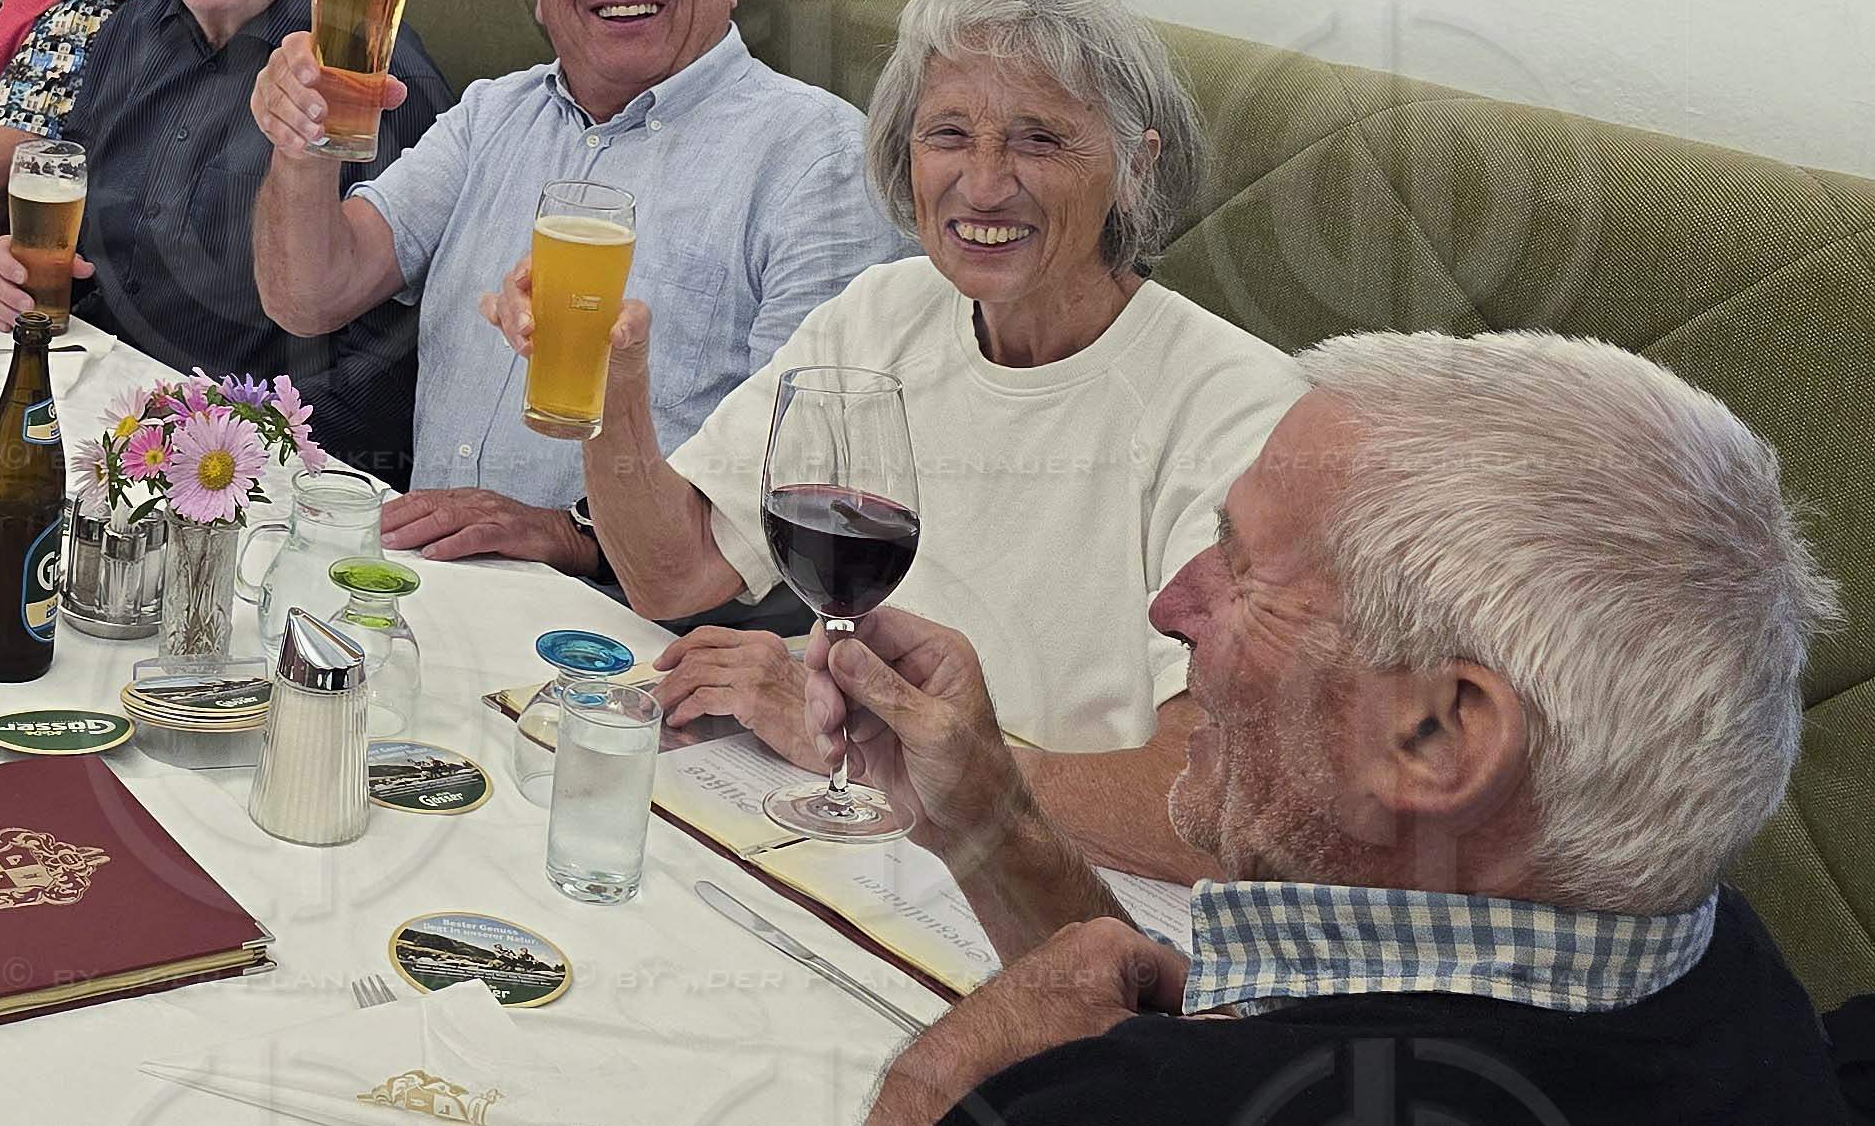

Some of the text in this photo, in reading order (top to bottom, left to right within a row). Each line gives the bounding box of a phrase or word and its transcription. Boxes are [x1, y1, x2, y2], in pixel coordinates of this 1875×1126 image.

[0, 719, 117, 735] Gösser
[419, 791, 463, 807] Gösser
[442, 918, 519, 936] Bester Genuss
